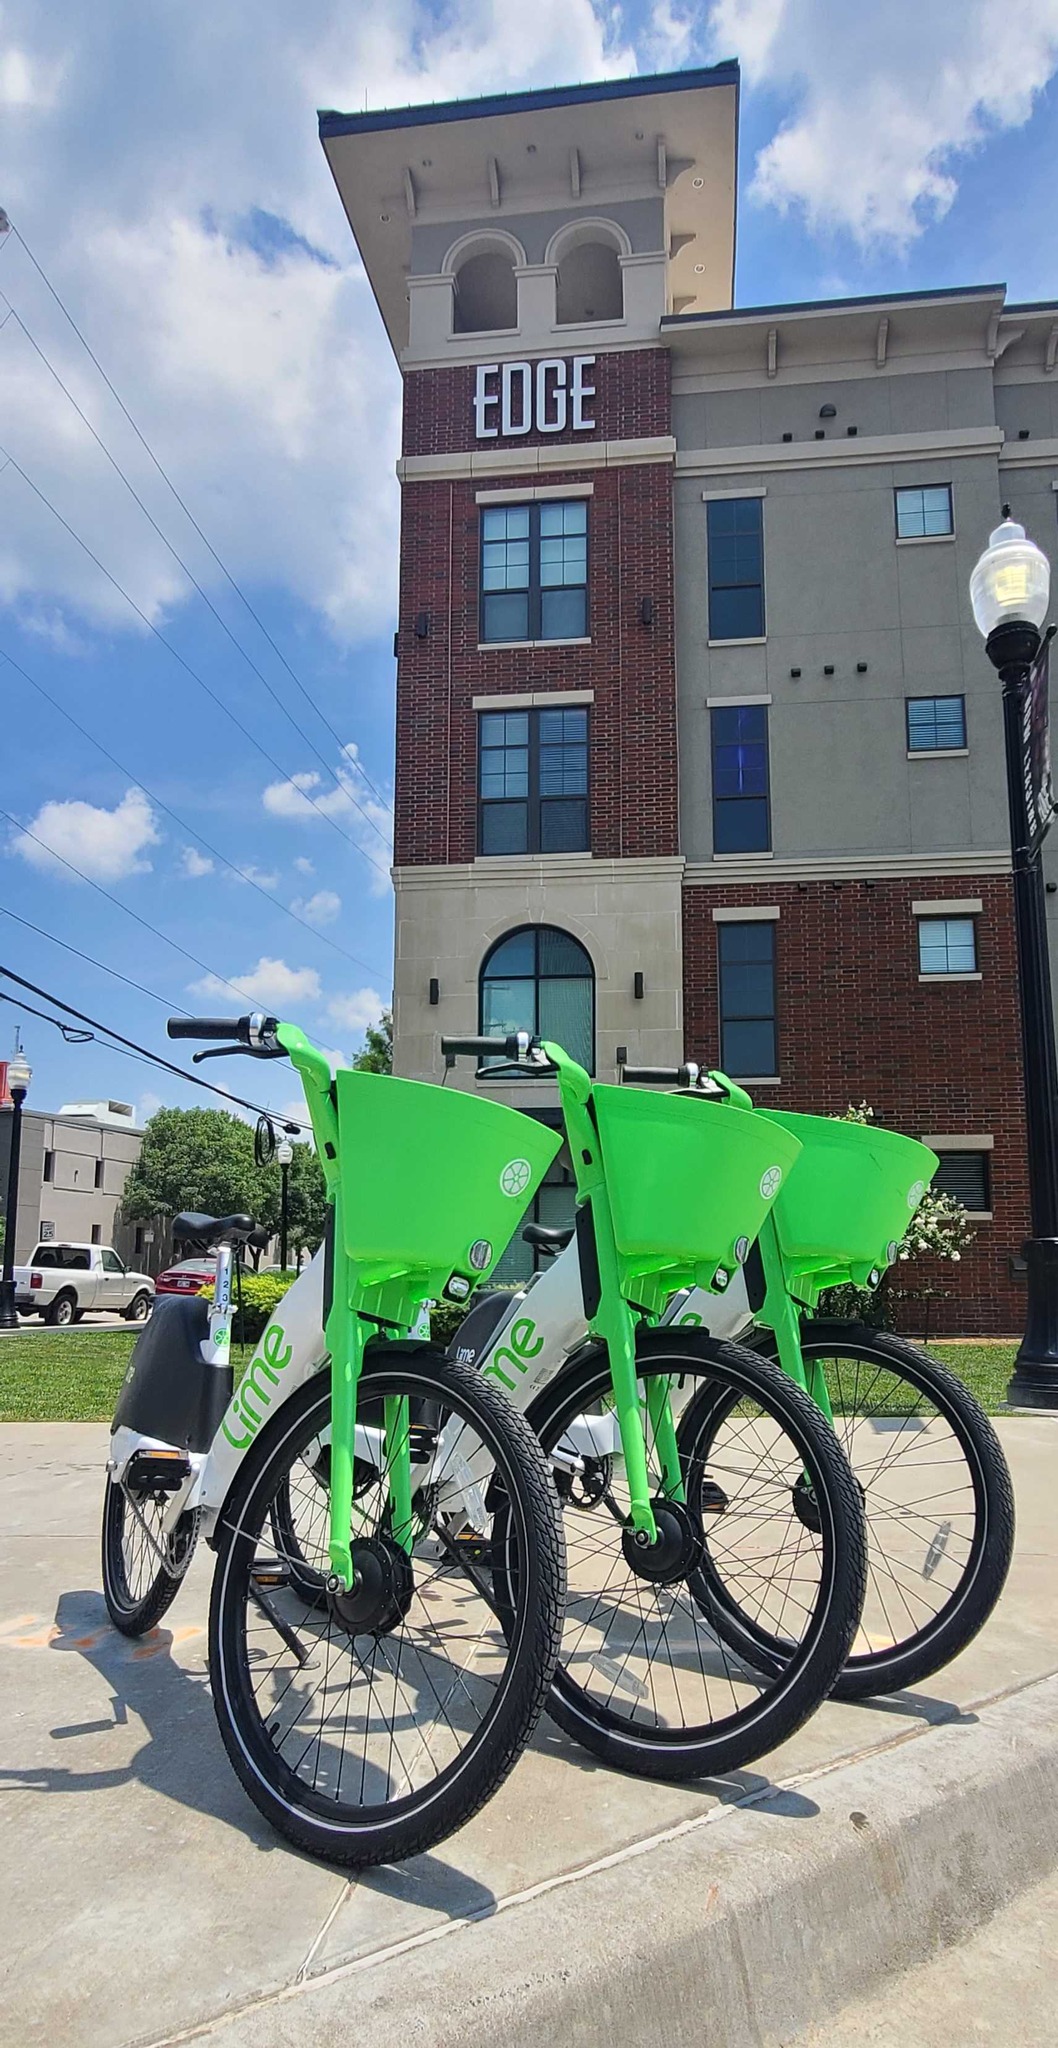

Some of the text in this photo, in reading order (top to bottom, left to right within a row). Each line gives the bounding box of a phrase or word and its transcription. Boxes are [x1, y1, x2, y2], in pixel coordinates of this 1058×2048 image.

[473, 355, 596, 439] EDGE
[224, 1267, 229, 1275] 1
[222, 1280, 229, 1289] 2
[222, 1293, 228, 1302] 3
[483, 1317, 544, 1391] me
